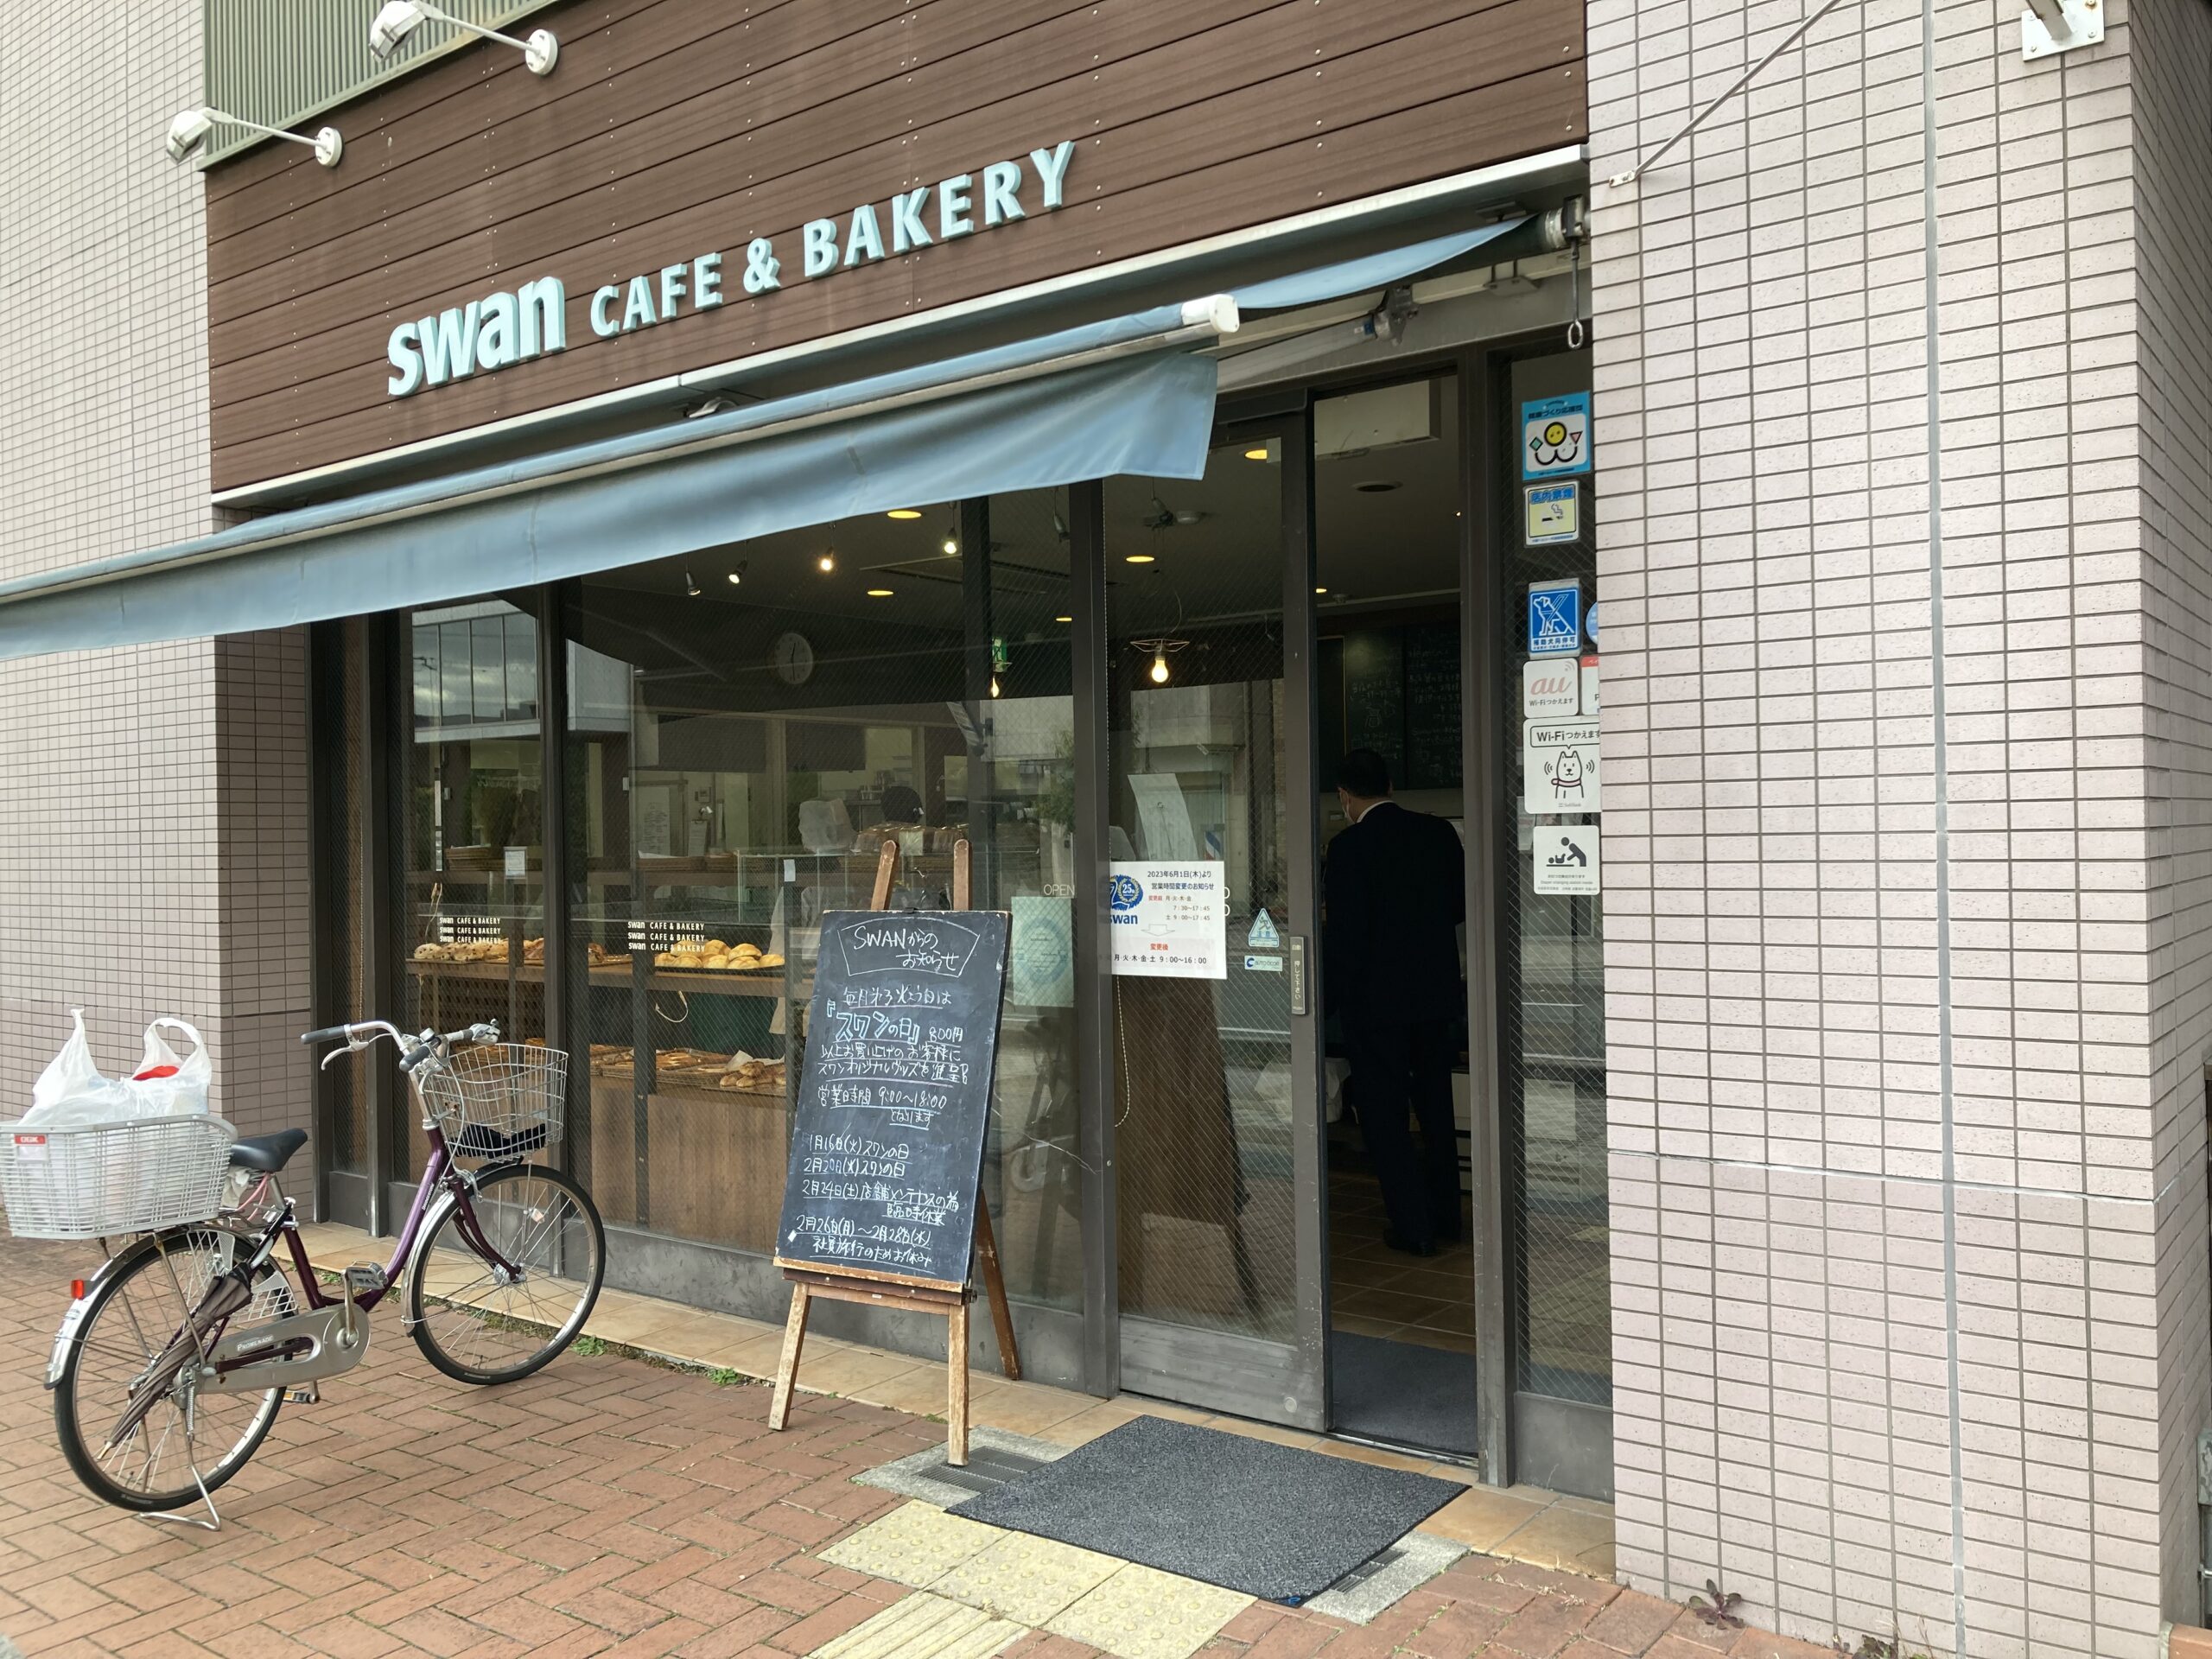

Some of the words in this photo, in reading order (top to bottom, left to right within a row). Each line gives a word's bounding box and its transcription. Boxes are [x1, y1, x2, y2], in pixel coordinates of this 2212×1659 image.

[387, 275, 566, 397] swan
[589, 251, 724, 337] CAFE
[743, 237, 781, 294] &
[803, 140, 1075, 279] BAKERY
[1530, 677, 1573, 696] au
[1044, 884, 1075, 896] OPEN
[1110, 914, 1138, 925] wan
[677, 933, 705, 942] BAKERY
[677, 944, 705, 952] BAKERY
[1150, 943, 1169, 951] 変更後
[896, 949, 959, 973] お知らせ
[929, 1026, 963, 1042] 800円
[818, 1084, 872, 1107] 営業時間
